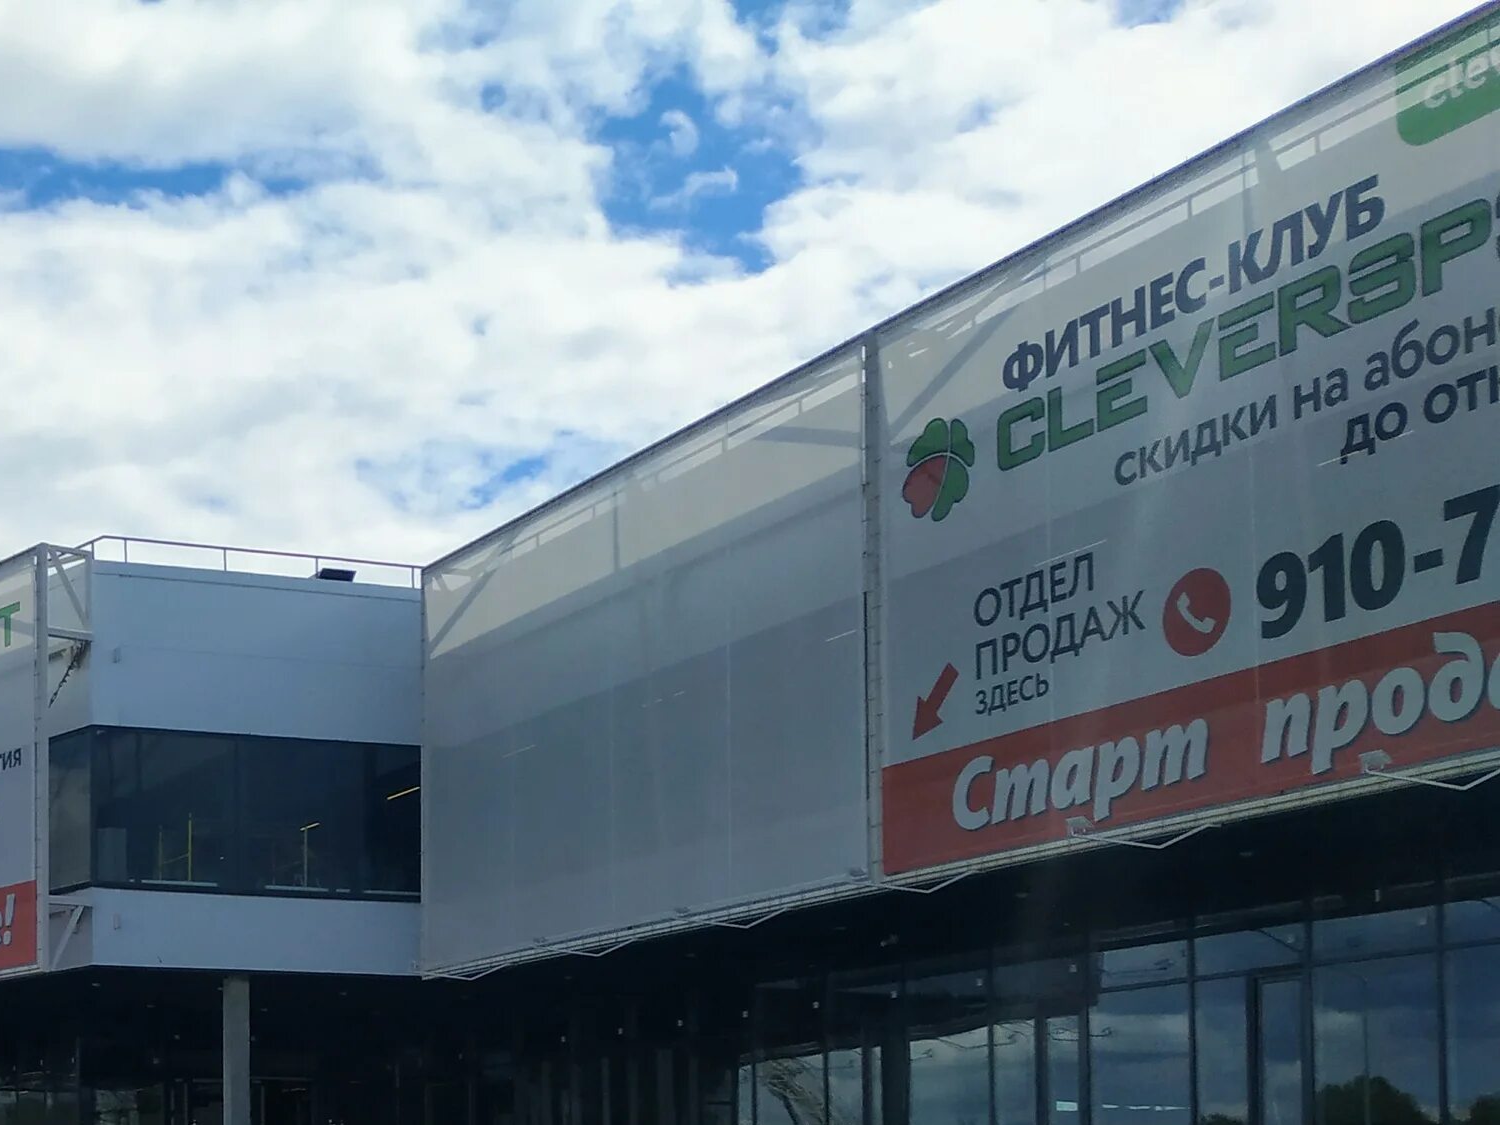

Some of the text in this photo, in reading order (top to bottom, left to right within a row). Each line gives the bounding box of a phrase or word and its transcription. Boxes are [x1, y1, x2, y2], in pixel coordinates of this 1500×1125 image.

[1424, 45, 1500, 109] cle
[996, 188, 1500, 472] CLEVERSP
[1003, 173, 1386, 393] ФИТНЕС-КЛУБ
[1294, 367, 1350, 421] на
[1364, 306, 1500, 392] абон
[1340, 401, 1409, 465] до
[974, 552, 1096, 628] ОТДЕЛ
[1255, 484, 1500, 640] 910-7
[974, 589, 1146, 681] ПРОДАЖ
[952, 631, 1500, 832] Старт прод
[974, 674, 1050, 716] ЗДЕСЬ
